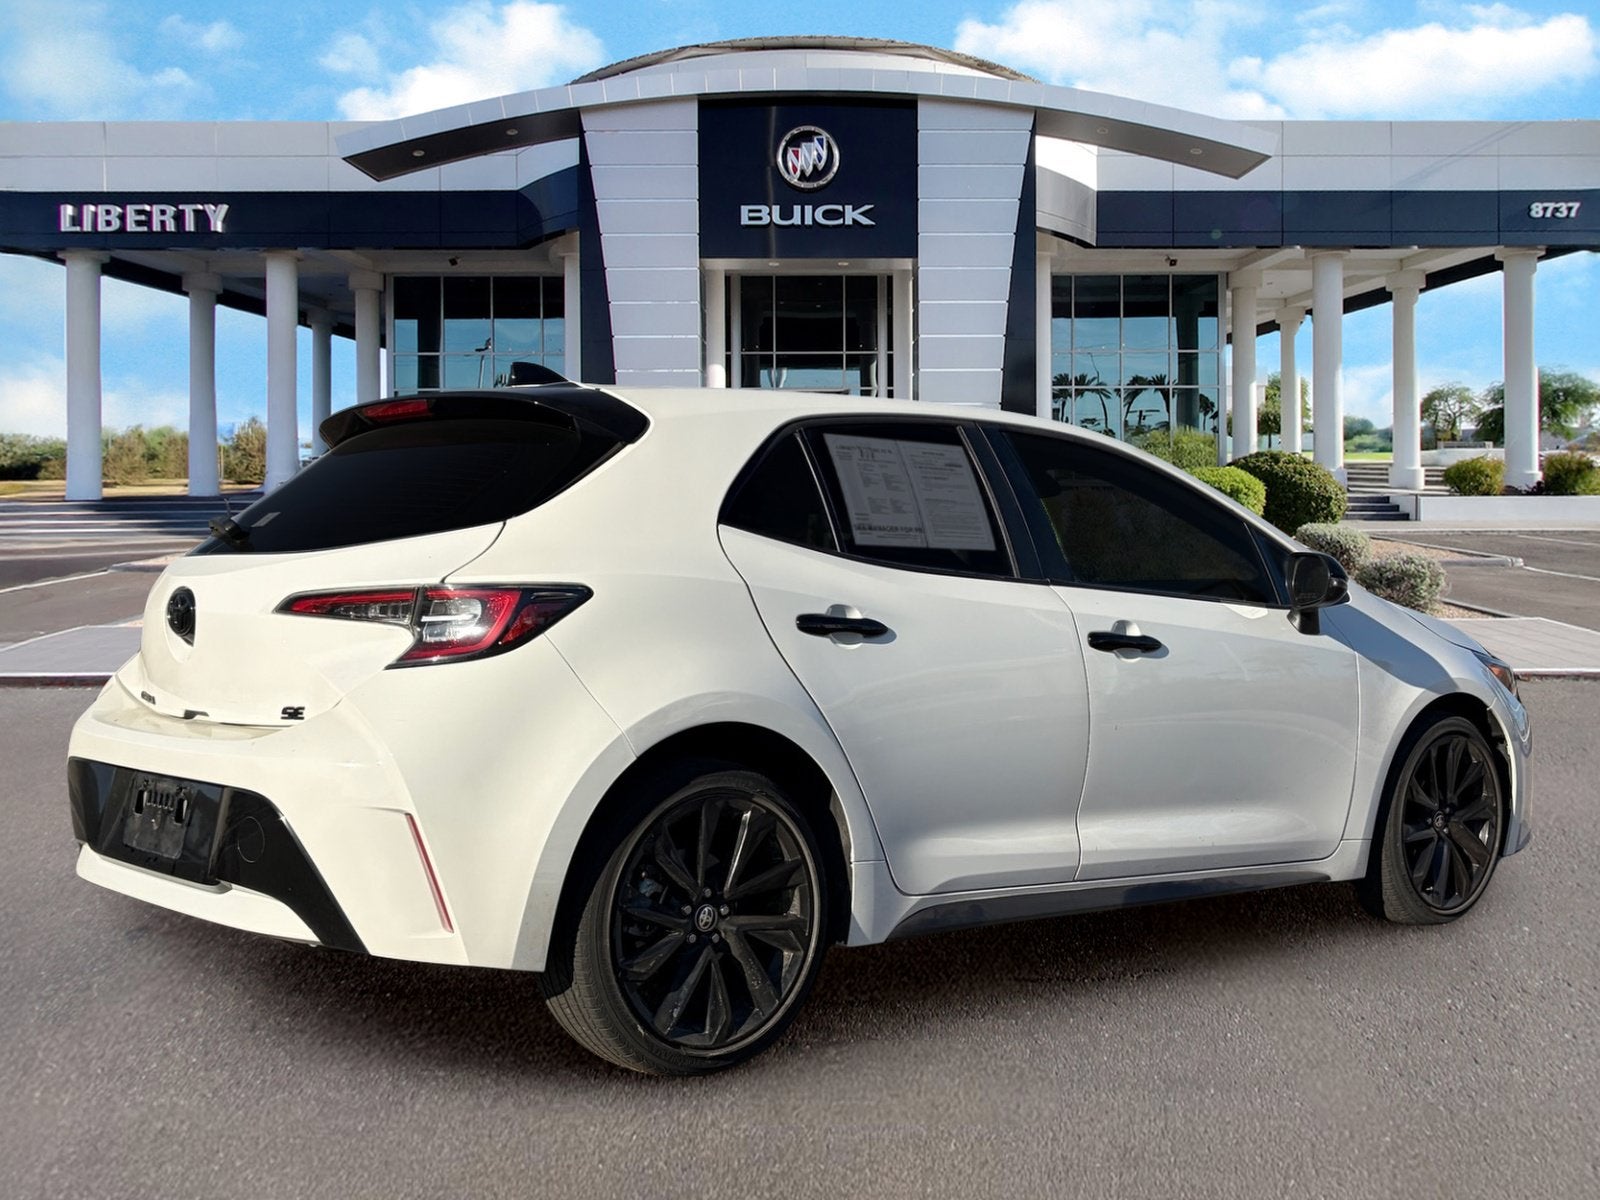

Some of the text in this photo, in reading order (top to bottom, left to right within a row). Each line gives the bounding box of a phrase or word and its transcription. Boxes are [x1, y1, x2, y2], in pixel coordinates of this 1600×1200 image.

[59, 204, 229, 232] LIBERTY
[740, 205, 876, 225] BUICK
[1529, 202, 1580, 218] 8737
[281, 706, 305, 720] SE
